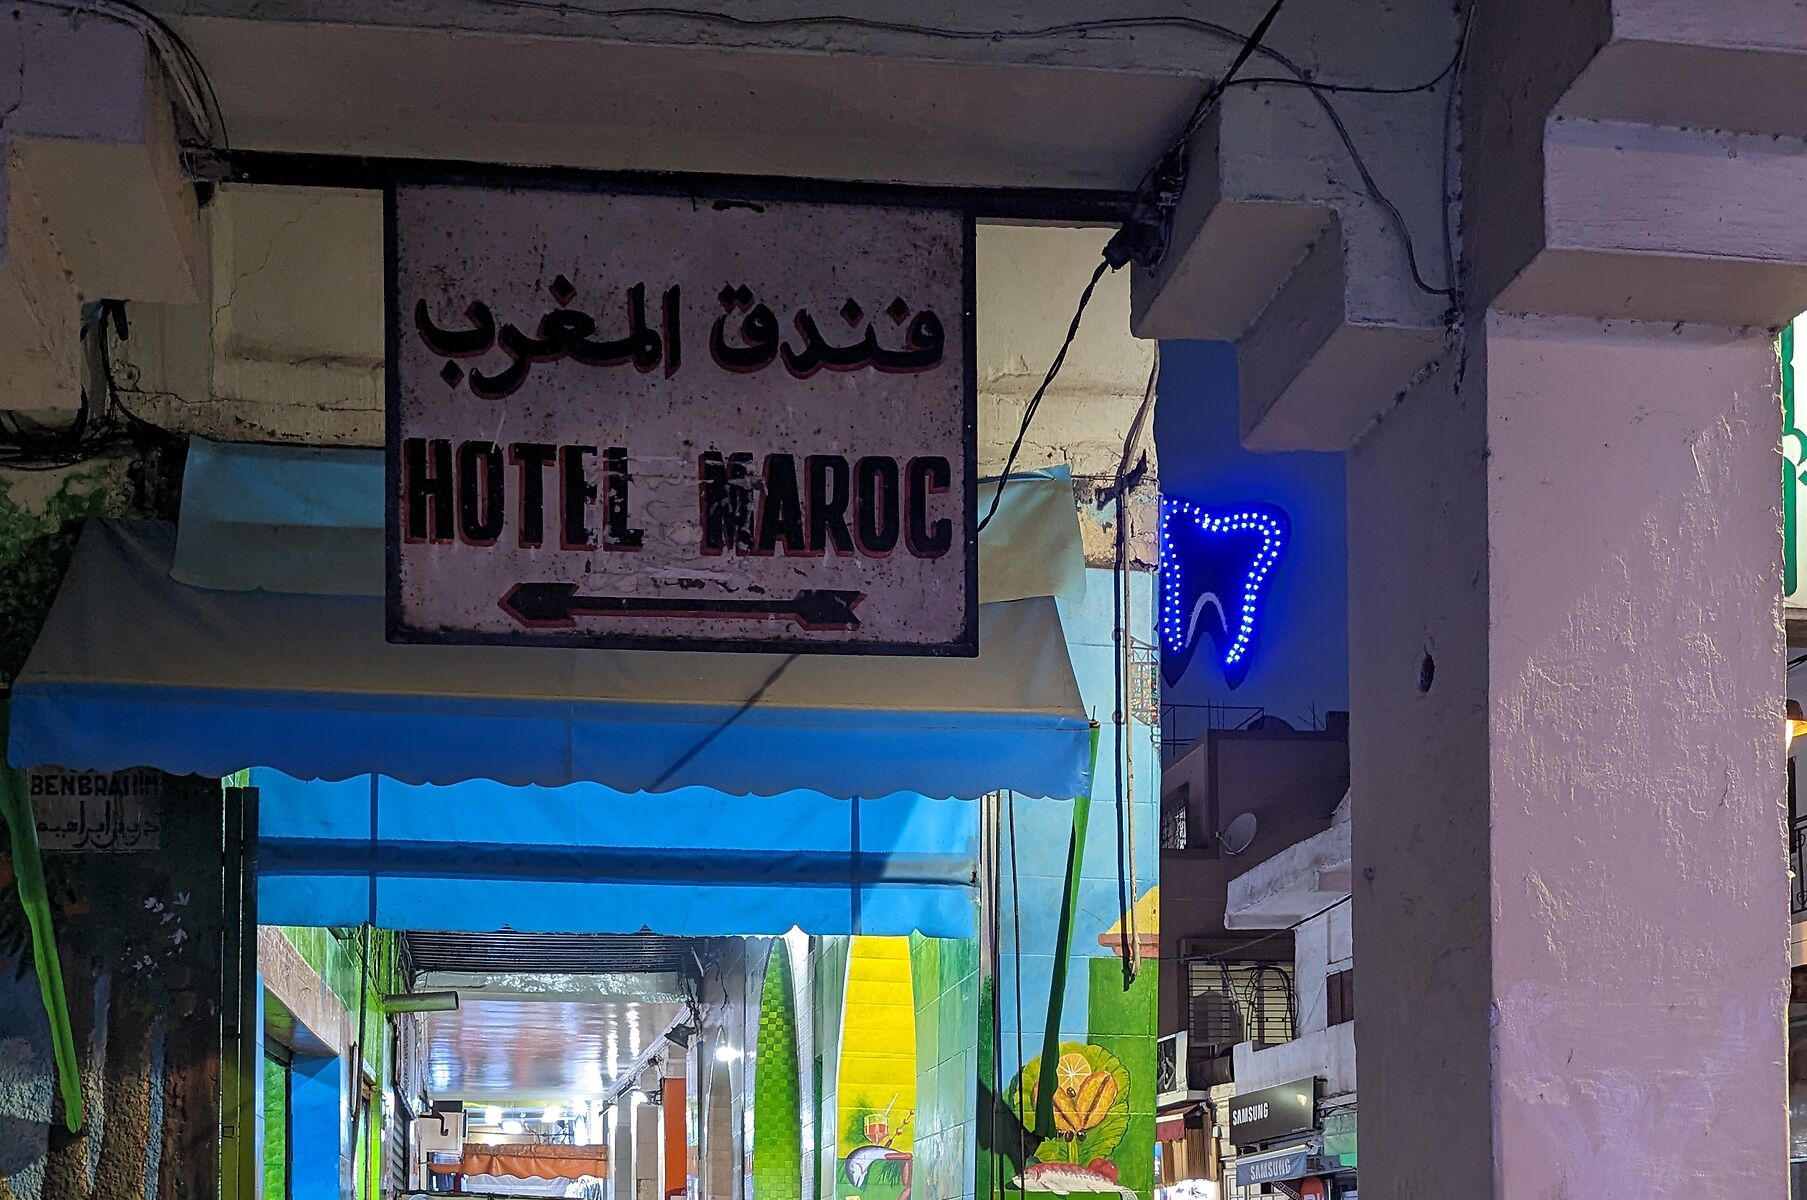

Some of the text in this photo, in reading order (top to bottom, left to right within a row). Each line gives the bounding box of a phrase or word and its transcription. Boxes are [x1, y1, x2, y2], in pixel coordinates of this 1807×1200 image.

[414, 273, 946, 400] فندق المغرب
[403, 436, 953, 560] HOTEL MAROC
[1232, 1102, 1269, 1126] SAMSUNG
[1250, 1158, 1291, 1181] SAMSUNG
